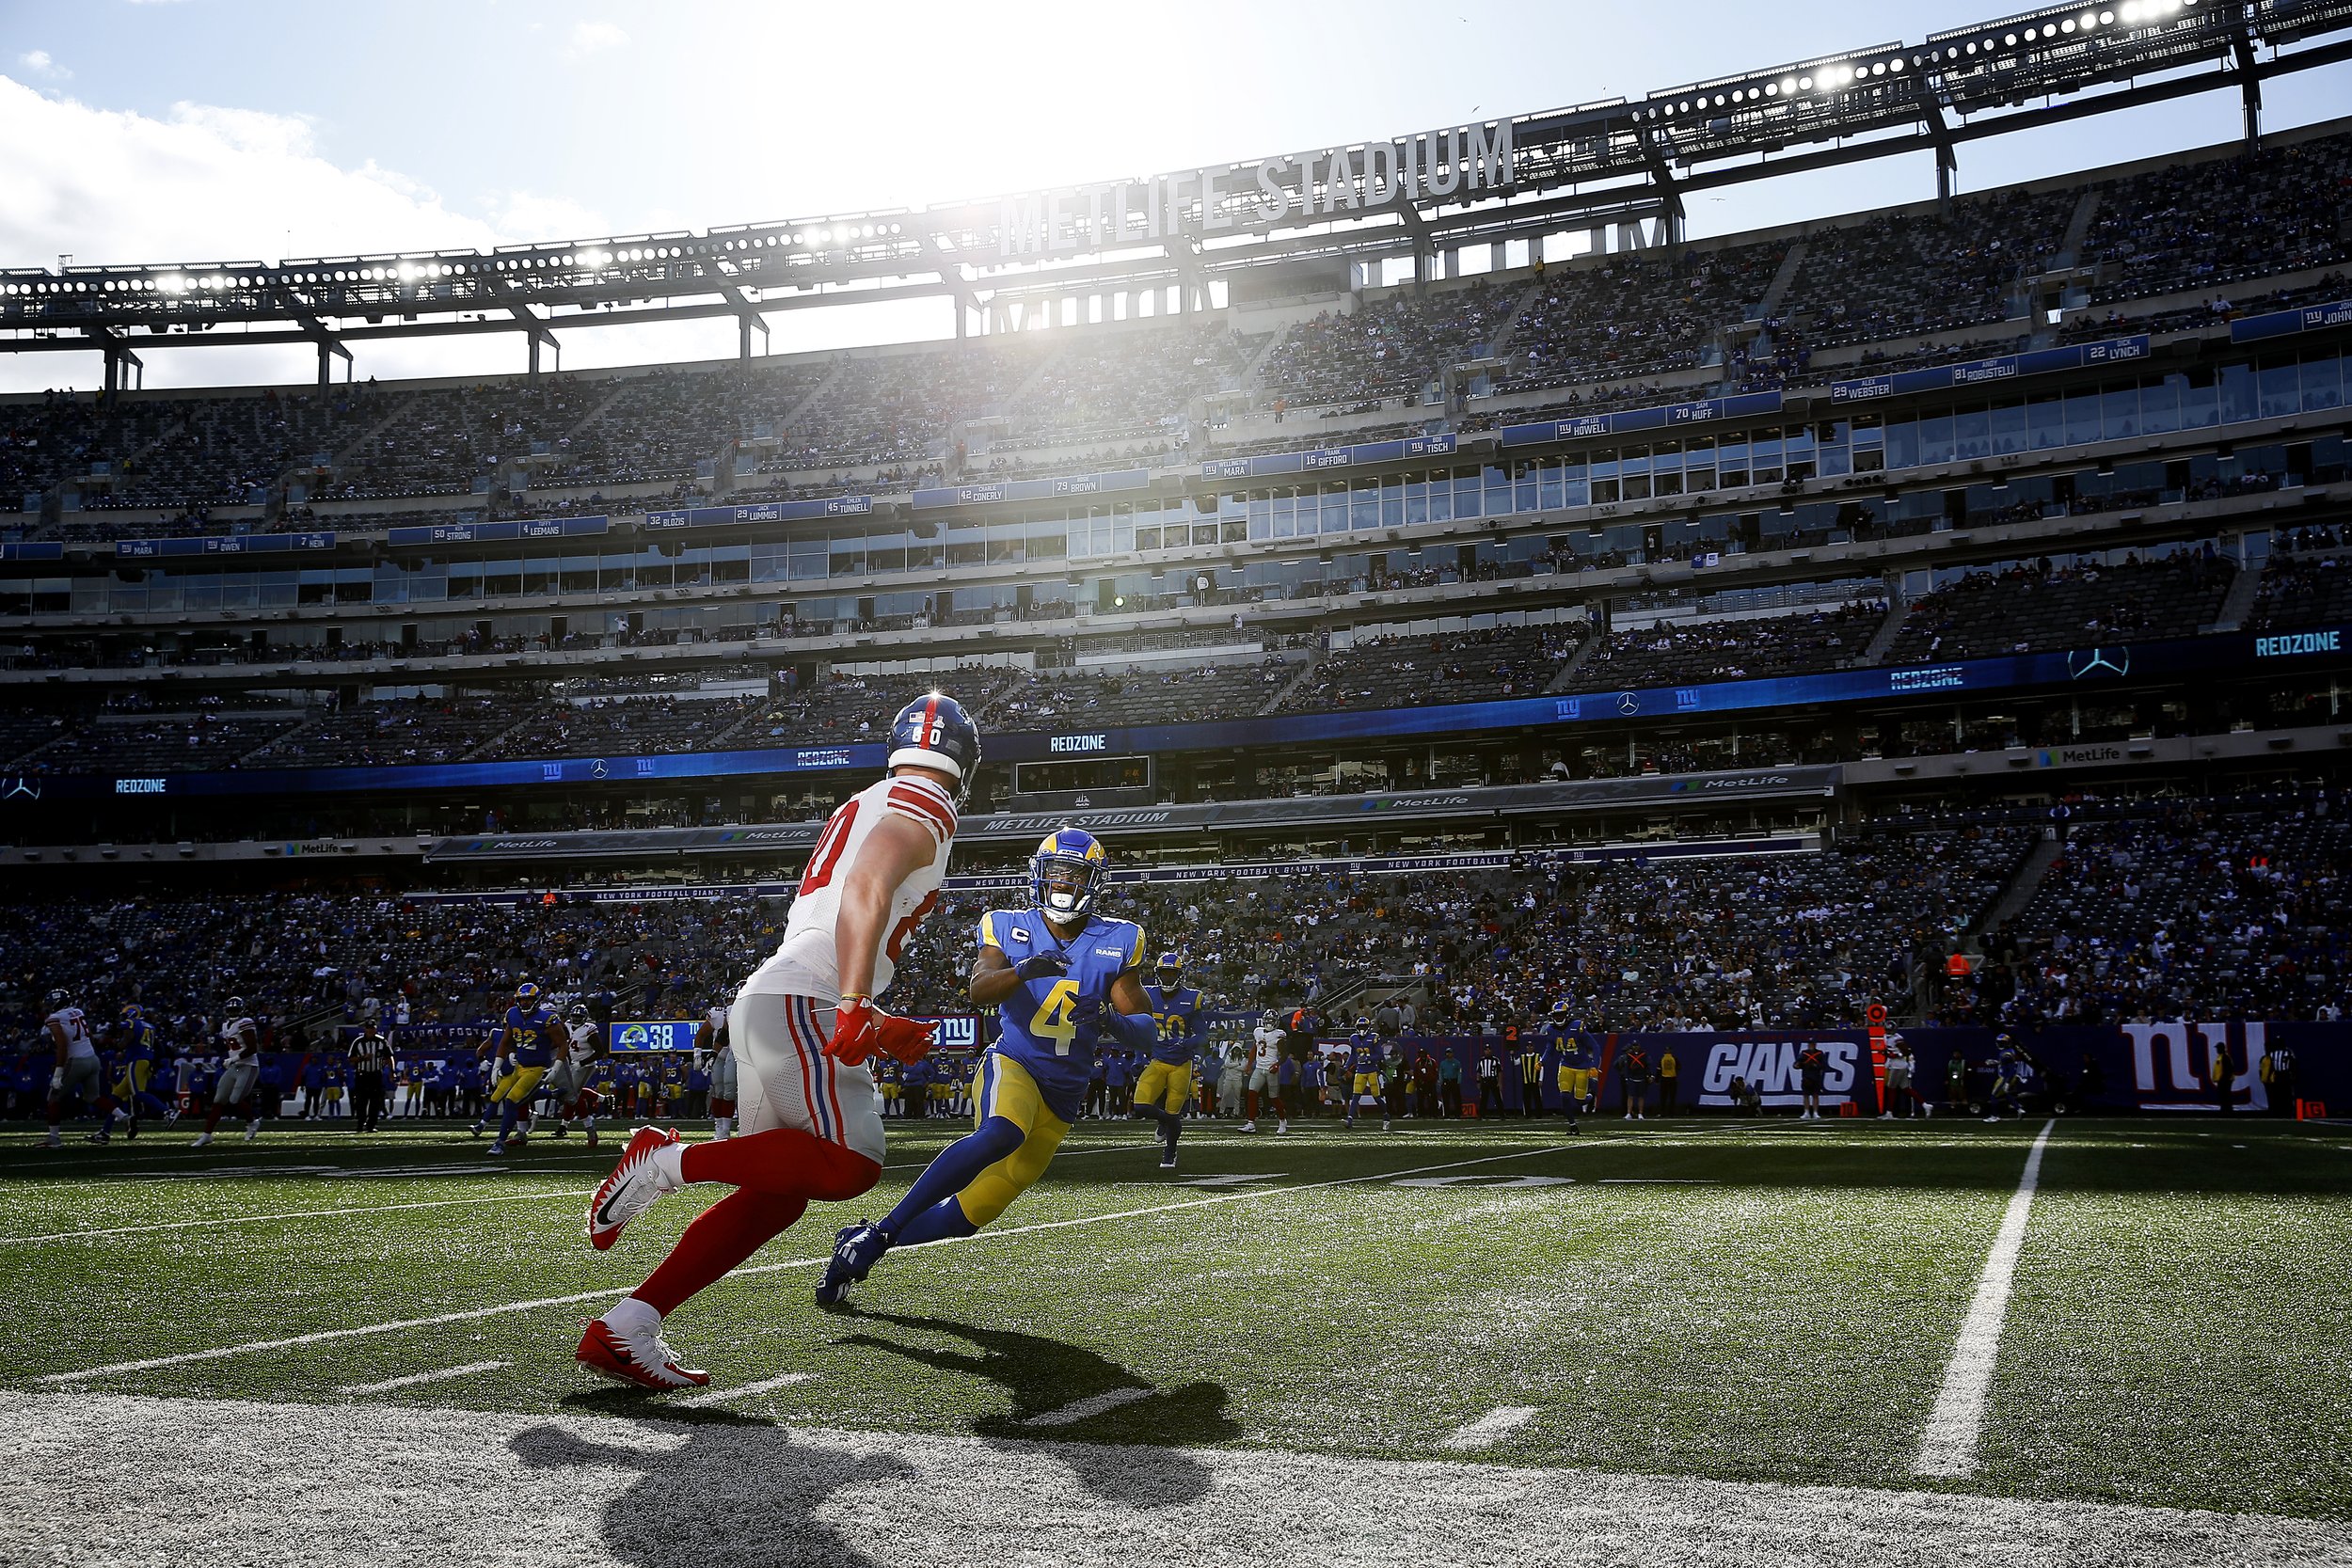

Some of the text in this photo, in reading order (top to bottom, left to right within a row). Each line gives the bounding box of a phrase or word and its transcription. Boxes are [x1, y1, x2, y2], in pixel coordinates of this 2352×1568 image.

[1000, 118, 1514, 257] METLIFE STADIUM
[2090, 346, 2139, 359] 22 LYNCH
[1955, 365, 2014, 381] 81 ROBUSTELLI
[1861, 378, 1875, 387] ALEX
[1834, 384, 1890, 399] 29 WEBSTER
[1676, 408, 1712, 420] 70 HUFF
[1574, 423, 1606, 436] HOWELL
[1325, 448, 1341, 456] FRANK
[1427, 442, 1448, 453] TISCH
[1218, 459, 1248, 467] WELLINGTON
[1306, 454, 1347, 467] 16 GIFFORD
[1223, 467, 1246, 477] MARA
[1057, 482, 1096, 492] 79 BROWN
[961, 490, 1002, 501] 42 CONERLY
[828, 502, 867, 514] 45 TUNNELL
[650, 515, 685, 527] 32 BLOZIS
[737, 510, 777, 520] 29 LUMMUS
[435, 530, 471, 541] 50 STRONG
[524, 524, 559, 535] 4 LEEMANS
[220, 543, 240, 552] OWEN
[301, 537, 325, 547] 7 HEIN
[134, 546, 152, 556] MARA
[2256, 631, 2341, 657] REDZONE
[1891, 667, 1963, 690] REDZONE
[1050, 734, 1106, 752] REDZONE
[797, 749, 850, 767] REDZONE
[2062, 748, 2121, 763] MetLife
[116, 779, 167, 794] REDZONE
[1704, 776, 1788, 788] MetLife
[1392, 796, 1469, 808] MetLife
[984, 811, 1170, 832] METLIFE STADIUM
[745, 830, 811, 840] MetLife
[301, 843, 339, 854] MetLife
[494, 839, 557, 849] MetLife
[1388, 861, 1411, 869] NEW
[1414, 859, 1441, 867] YORK
[1446, 856, 1498, 866] FOOTBALL
[1200, 869, 1225, 878] YORK
[1231, 867, 1280, 876] FOOTBALL
[1283, 864, 1320, 874] GIANTS
[596, 892, 615, 900] NEW
[619, 891, 643, 899] YORK
[645, 890, 690, 898] FOOTBALL
[1095, 948, 1121, 958] RAMS
[1029, 979, 1081, 1056] 4
[449, 1026, 488, 1037] FOOTB
[649, 1024, 674, 1051] 38
[944, 1018, 976, 1045] ny
[1505, 1025, 1518, 1041] 2
[1258, 1039, 1267, 1057] 3
[1555, 1037, 1579, 1055] 44
[2121, 1022, 2269, 1110] ny
[181, 1096, 191, 1109] G
